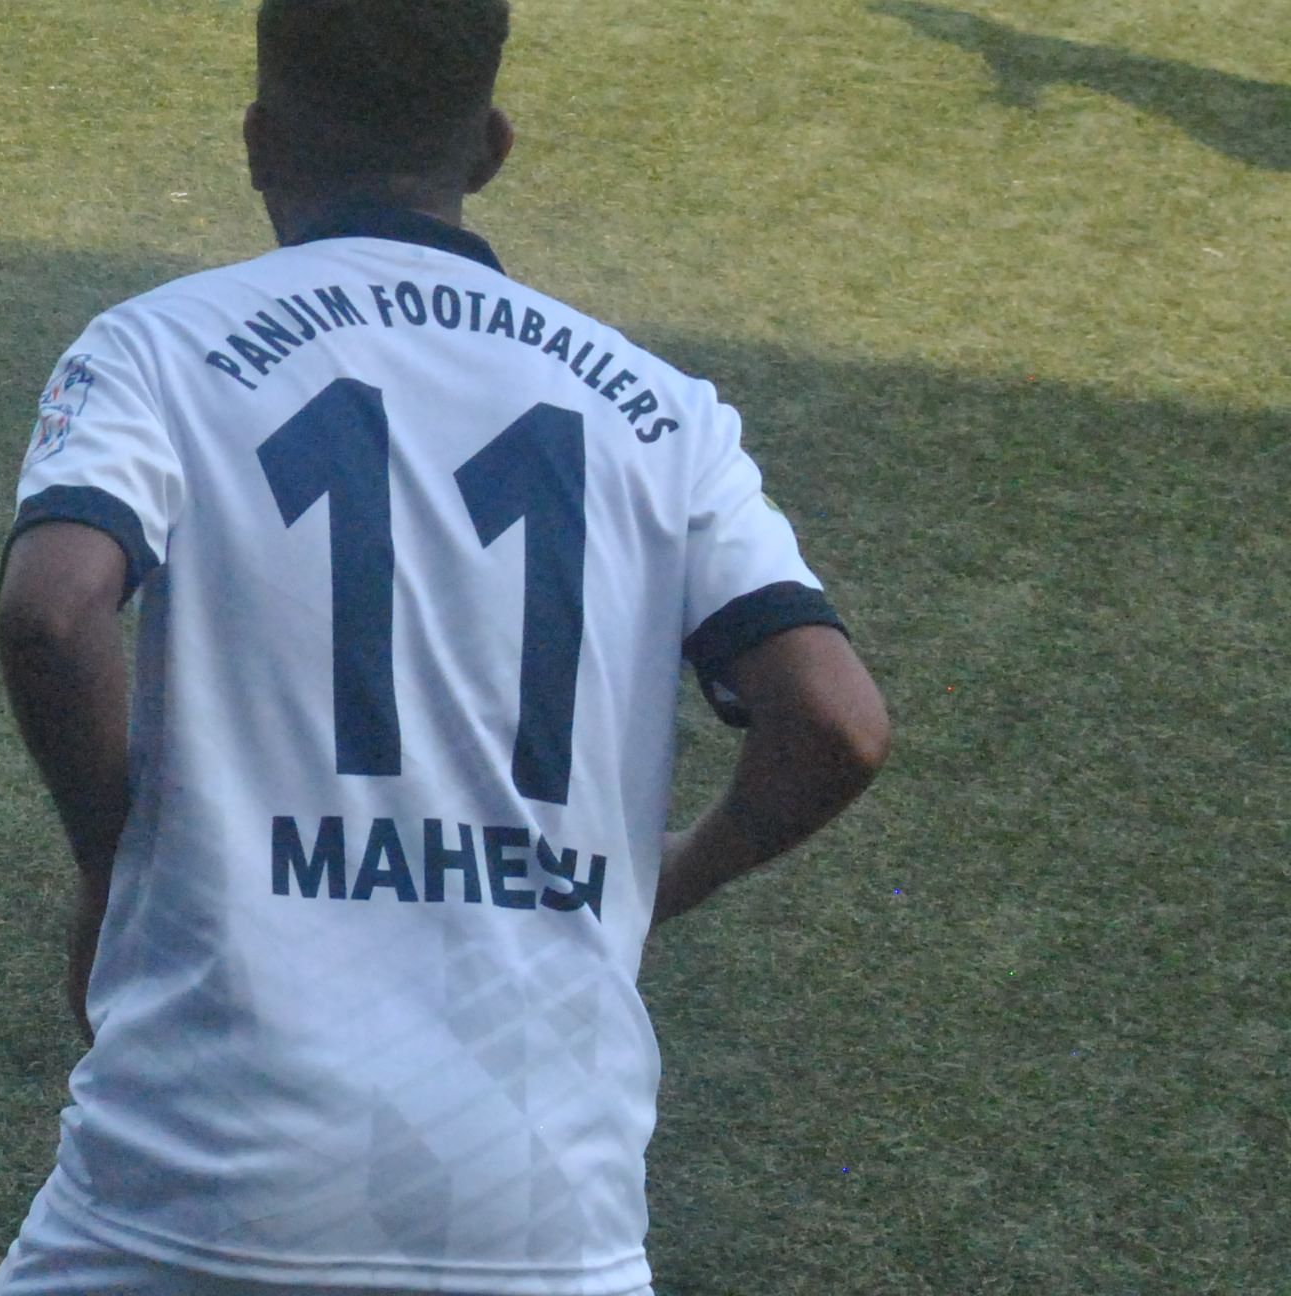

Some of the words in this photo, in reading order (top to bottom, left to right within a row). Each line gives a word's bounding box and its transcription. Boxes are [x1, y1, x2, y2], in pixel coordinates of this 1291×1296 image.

[205, 285, 368, 390] PANJIM
[367, 281, 679, 444] FOOTABALLERS
[256, 377, 587, 806] 11
